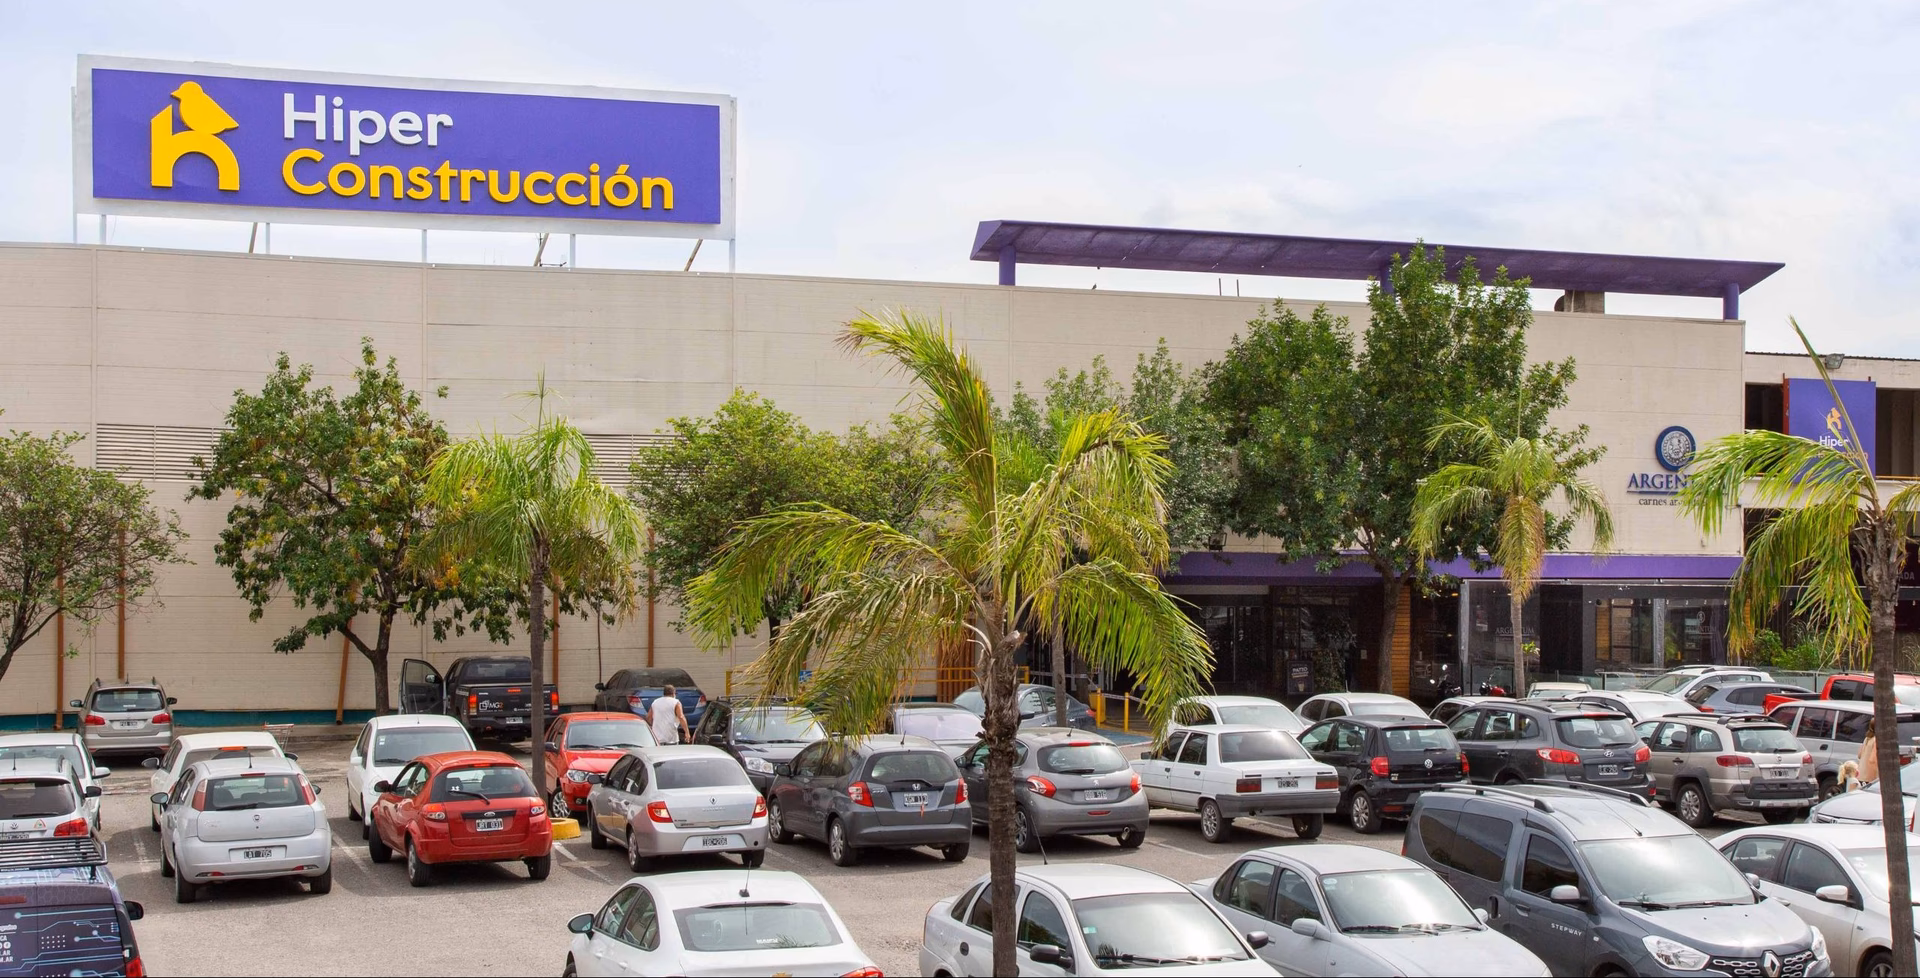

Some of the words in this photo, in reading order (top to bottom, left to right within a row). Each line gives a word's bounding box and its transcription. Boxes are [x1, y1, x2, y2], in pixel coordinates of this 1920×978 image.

[283, 92, 454, 157] Hiper
[281, 147, 675, 210] Construcción
[1819, 435, 1848, 449] Hiper
[1638, 498, 1667, 506] carnes
[1550, 922, 1582, 936] STEPWAY
